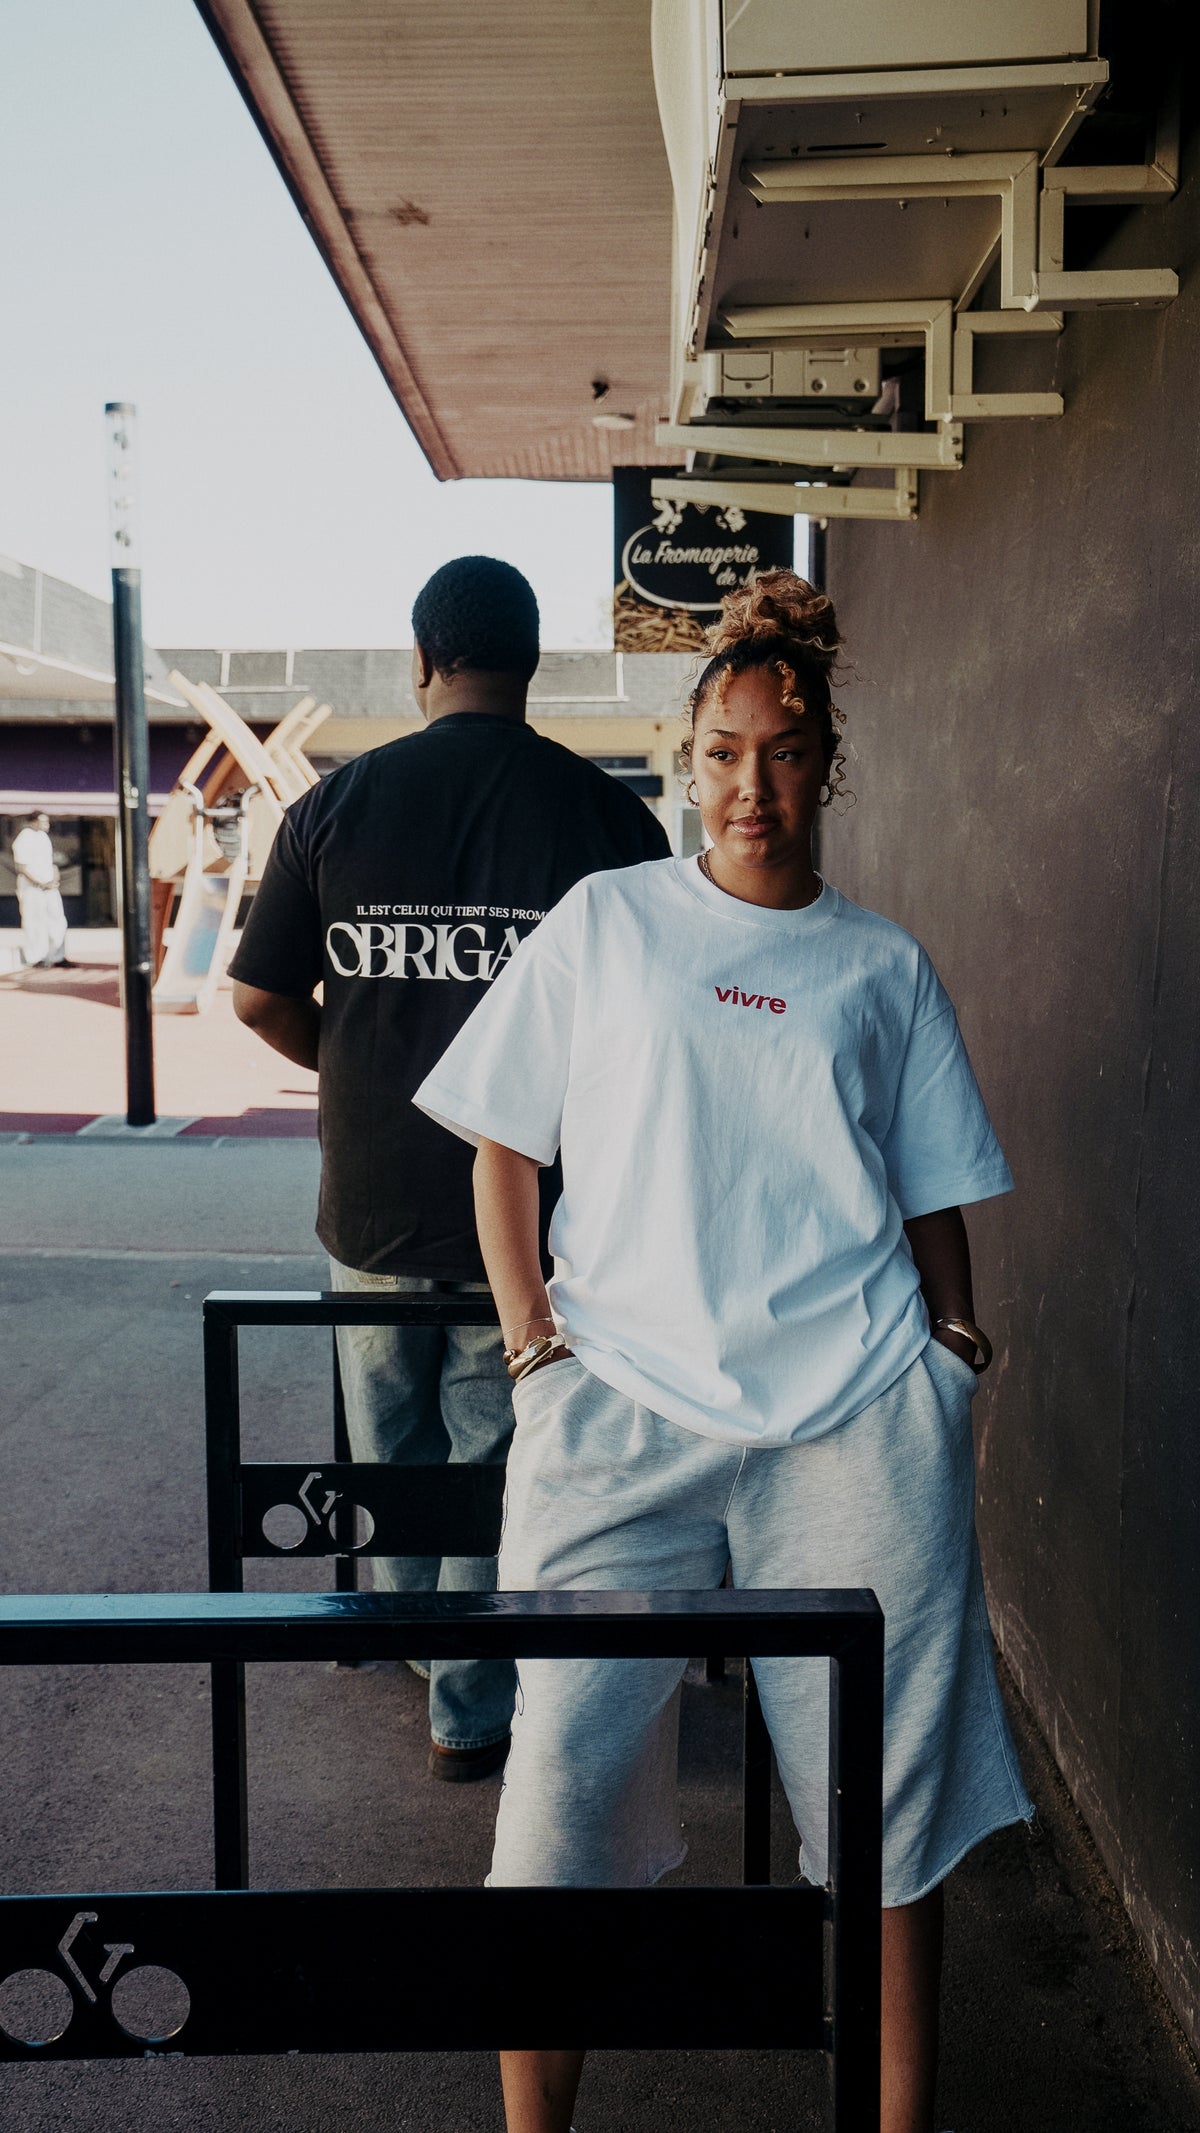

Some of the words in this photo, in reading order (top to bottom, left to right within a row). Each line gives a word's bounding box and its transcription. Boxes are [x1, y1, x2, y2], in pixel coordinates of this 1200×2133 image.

[631, 543, 652, 564] La
[653, 540, 759, 575] Fromagerie
[716, 566, 737, 586] de
[356, 905, 369, 916] IL
[369, 905, 391, 916] EST
[392, 904, 429, 916] CELUI
[431, 905, 453, 918] QUI
[455, 905, 487, 917] TIENT
[488, 906, 510, 919] SES
[326, 922, 533, 982] OBRIGA
[714, 985, 787, 1015] vivre
